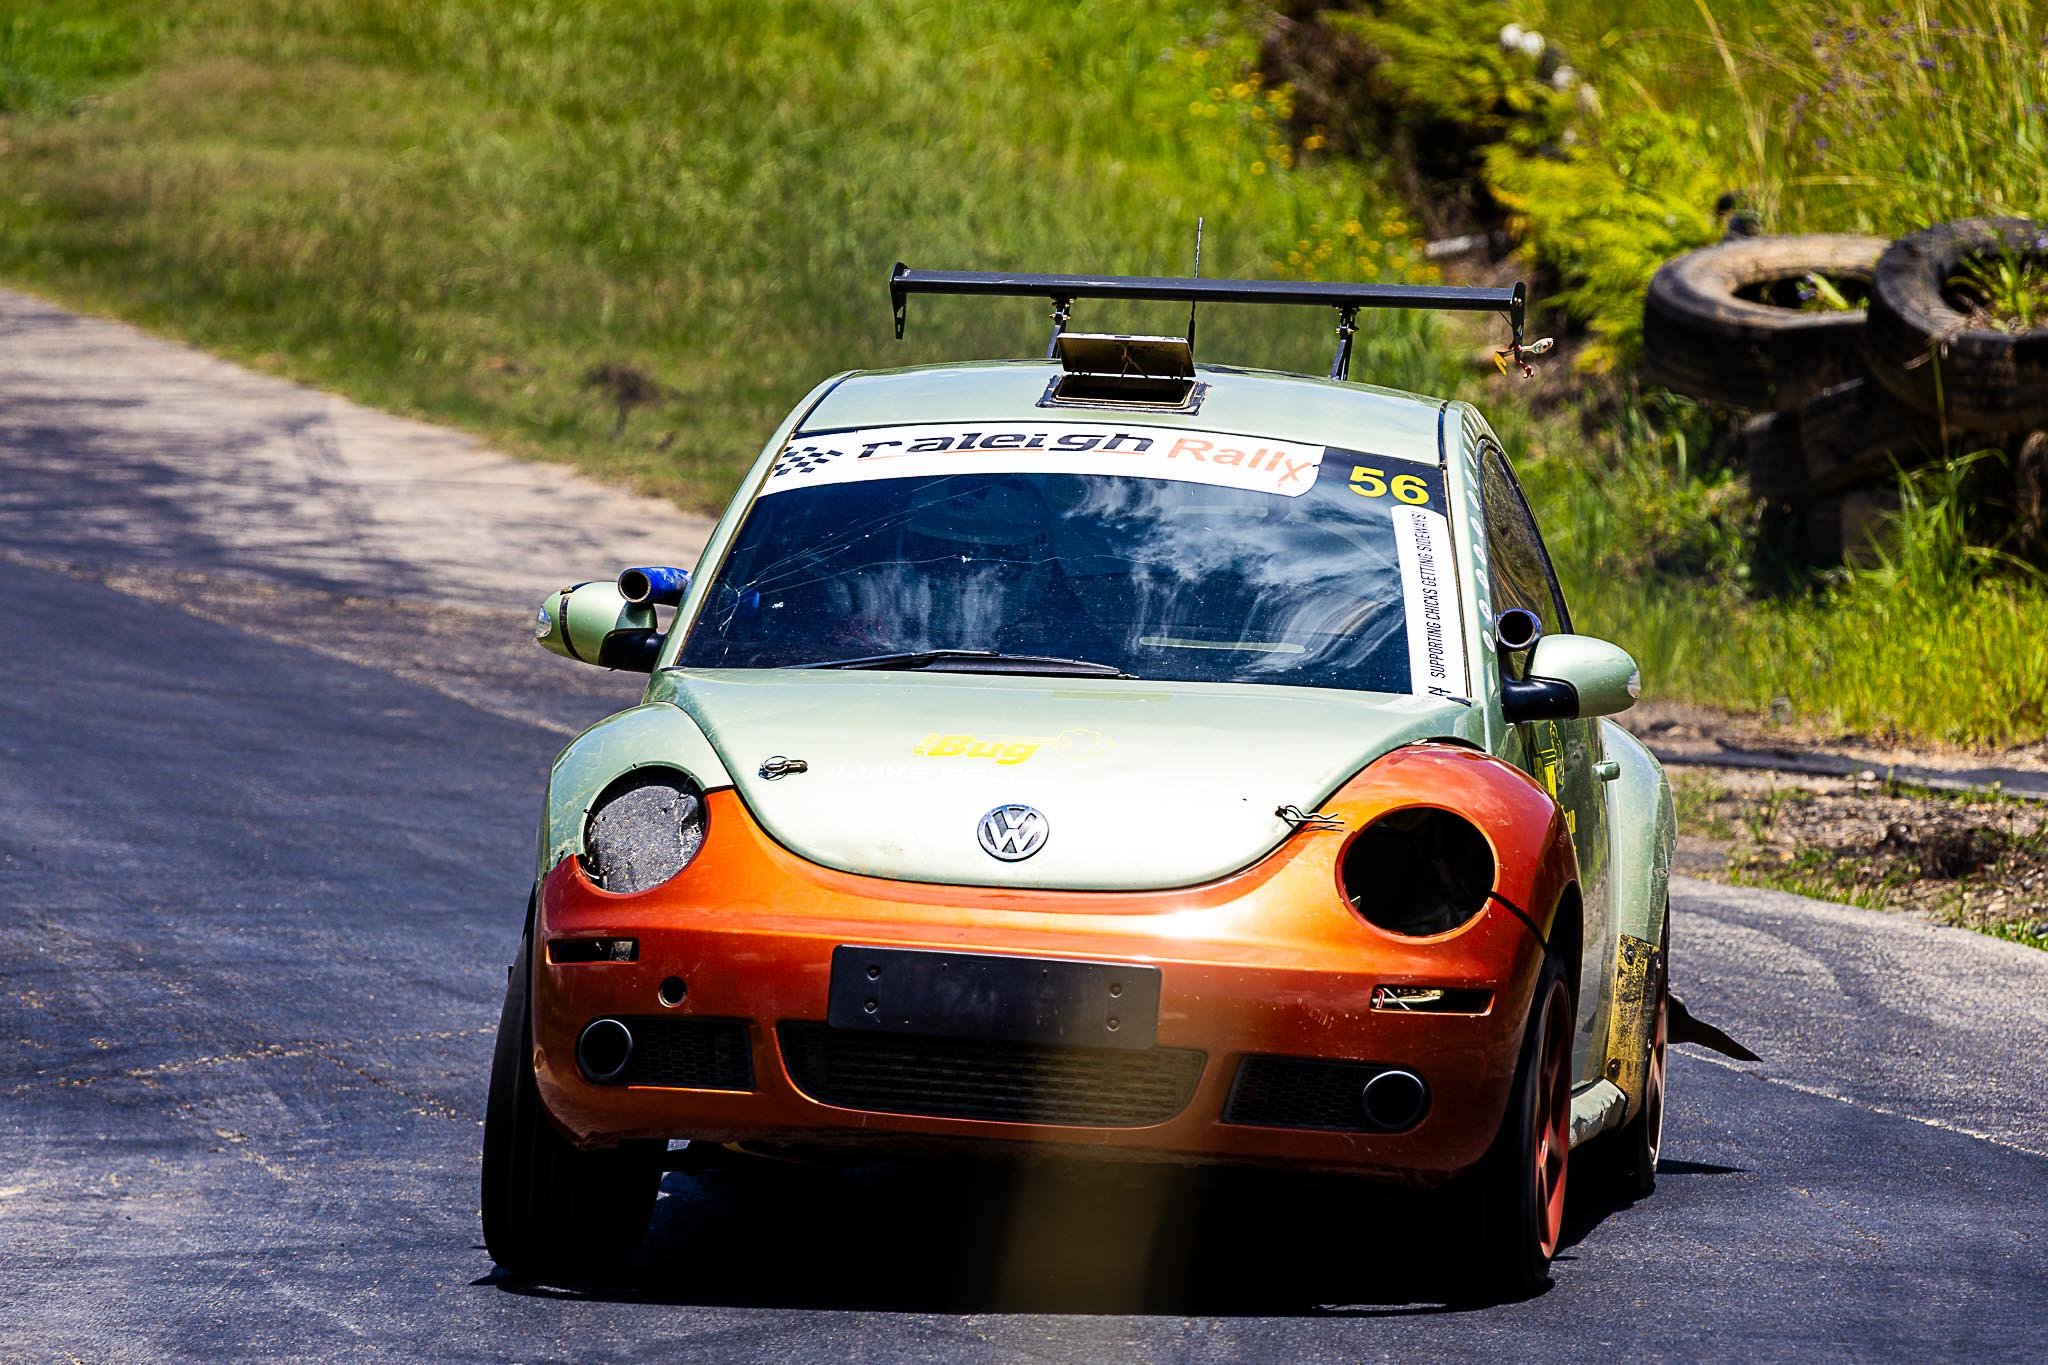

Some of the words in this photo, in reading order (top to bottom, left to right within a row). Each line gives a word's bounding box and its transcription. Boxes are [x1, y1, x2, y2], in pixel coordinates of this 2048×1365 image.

[857, 432, 1154, 458] raleigh
[1348, 465, 1430, 505] 56
[1418, 552, 1438, 588] GETTING
[1423, 588, 1441, 622] CHICKS
[1427, 622, 1446, 679] SUPPORTING
